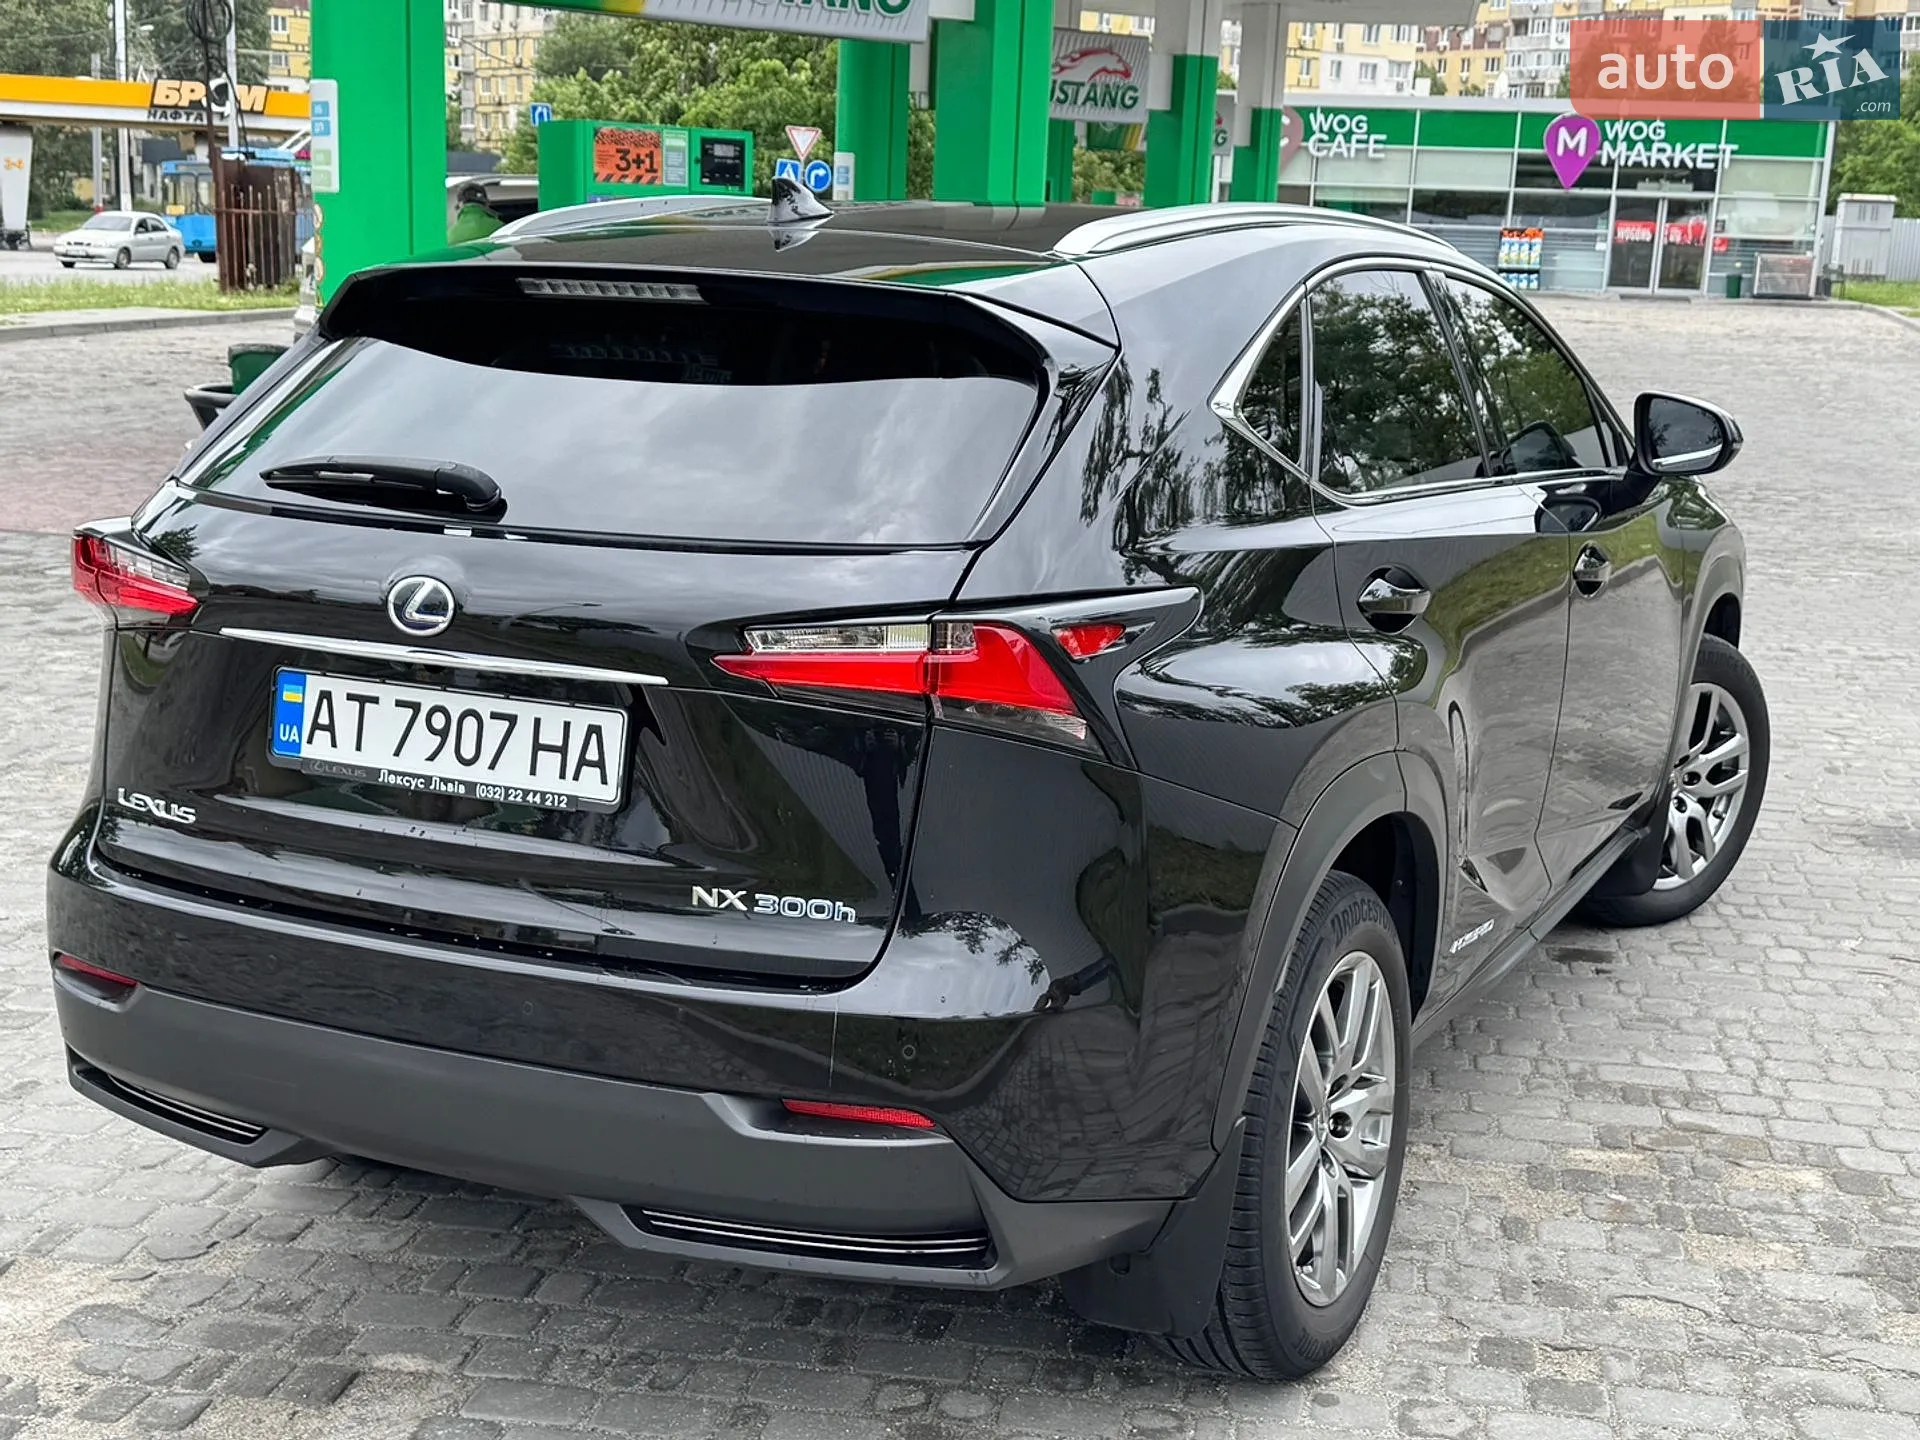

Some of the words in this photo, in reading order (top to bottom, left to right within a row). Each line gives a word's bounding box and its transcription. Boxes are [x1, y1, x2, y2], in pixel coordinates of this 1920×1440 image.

[147, 108, 204, 122] НАФТА
[1309, 112, 1368, 133] WOG
[1556, 126, 1588, 157] M
[1604, 120, 1666, 141] WOG
[1307, 132, 1388, 159] CAFE
[1600, 140, 1740, 170] MARKET
[615, 147, 659, 174] 3+1
[279, 723, 300, 744] UA
[306, 689, 380, 752] AT
[392, 698, 519, 772] 7907
[529, 716, 609, 786] HA
[325, 764, 367, 778] LEXUS
[378, 769, 425, 790] Лексус
[429, 776, 466, 794] Львів
[117, 787, 197, 824] LEXUS
[475, 783, 505, 801] (032)
[507, 789, 524, 802] 22
[526, 791, 542, 804] 44
[544, 793, 568, 808] 212
[692, 885, 749, 911] NX
[752, 893, 857, 923] 300h
[1331, 897, 1396, 947] BRIDGESTO
